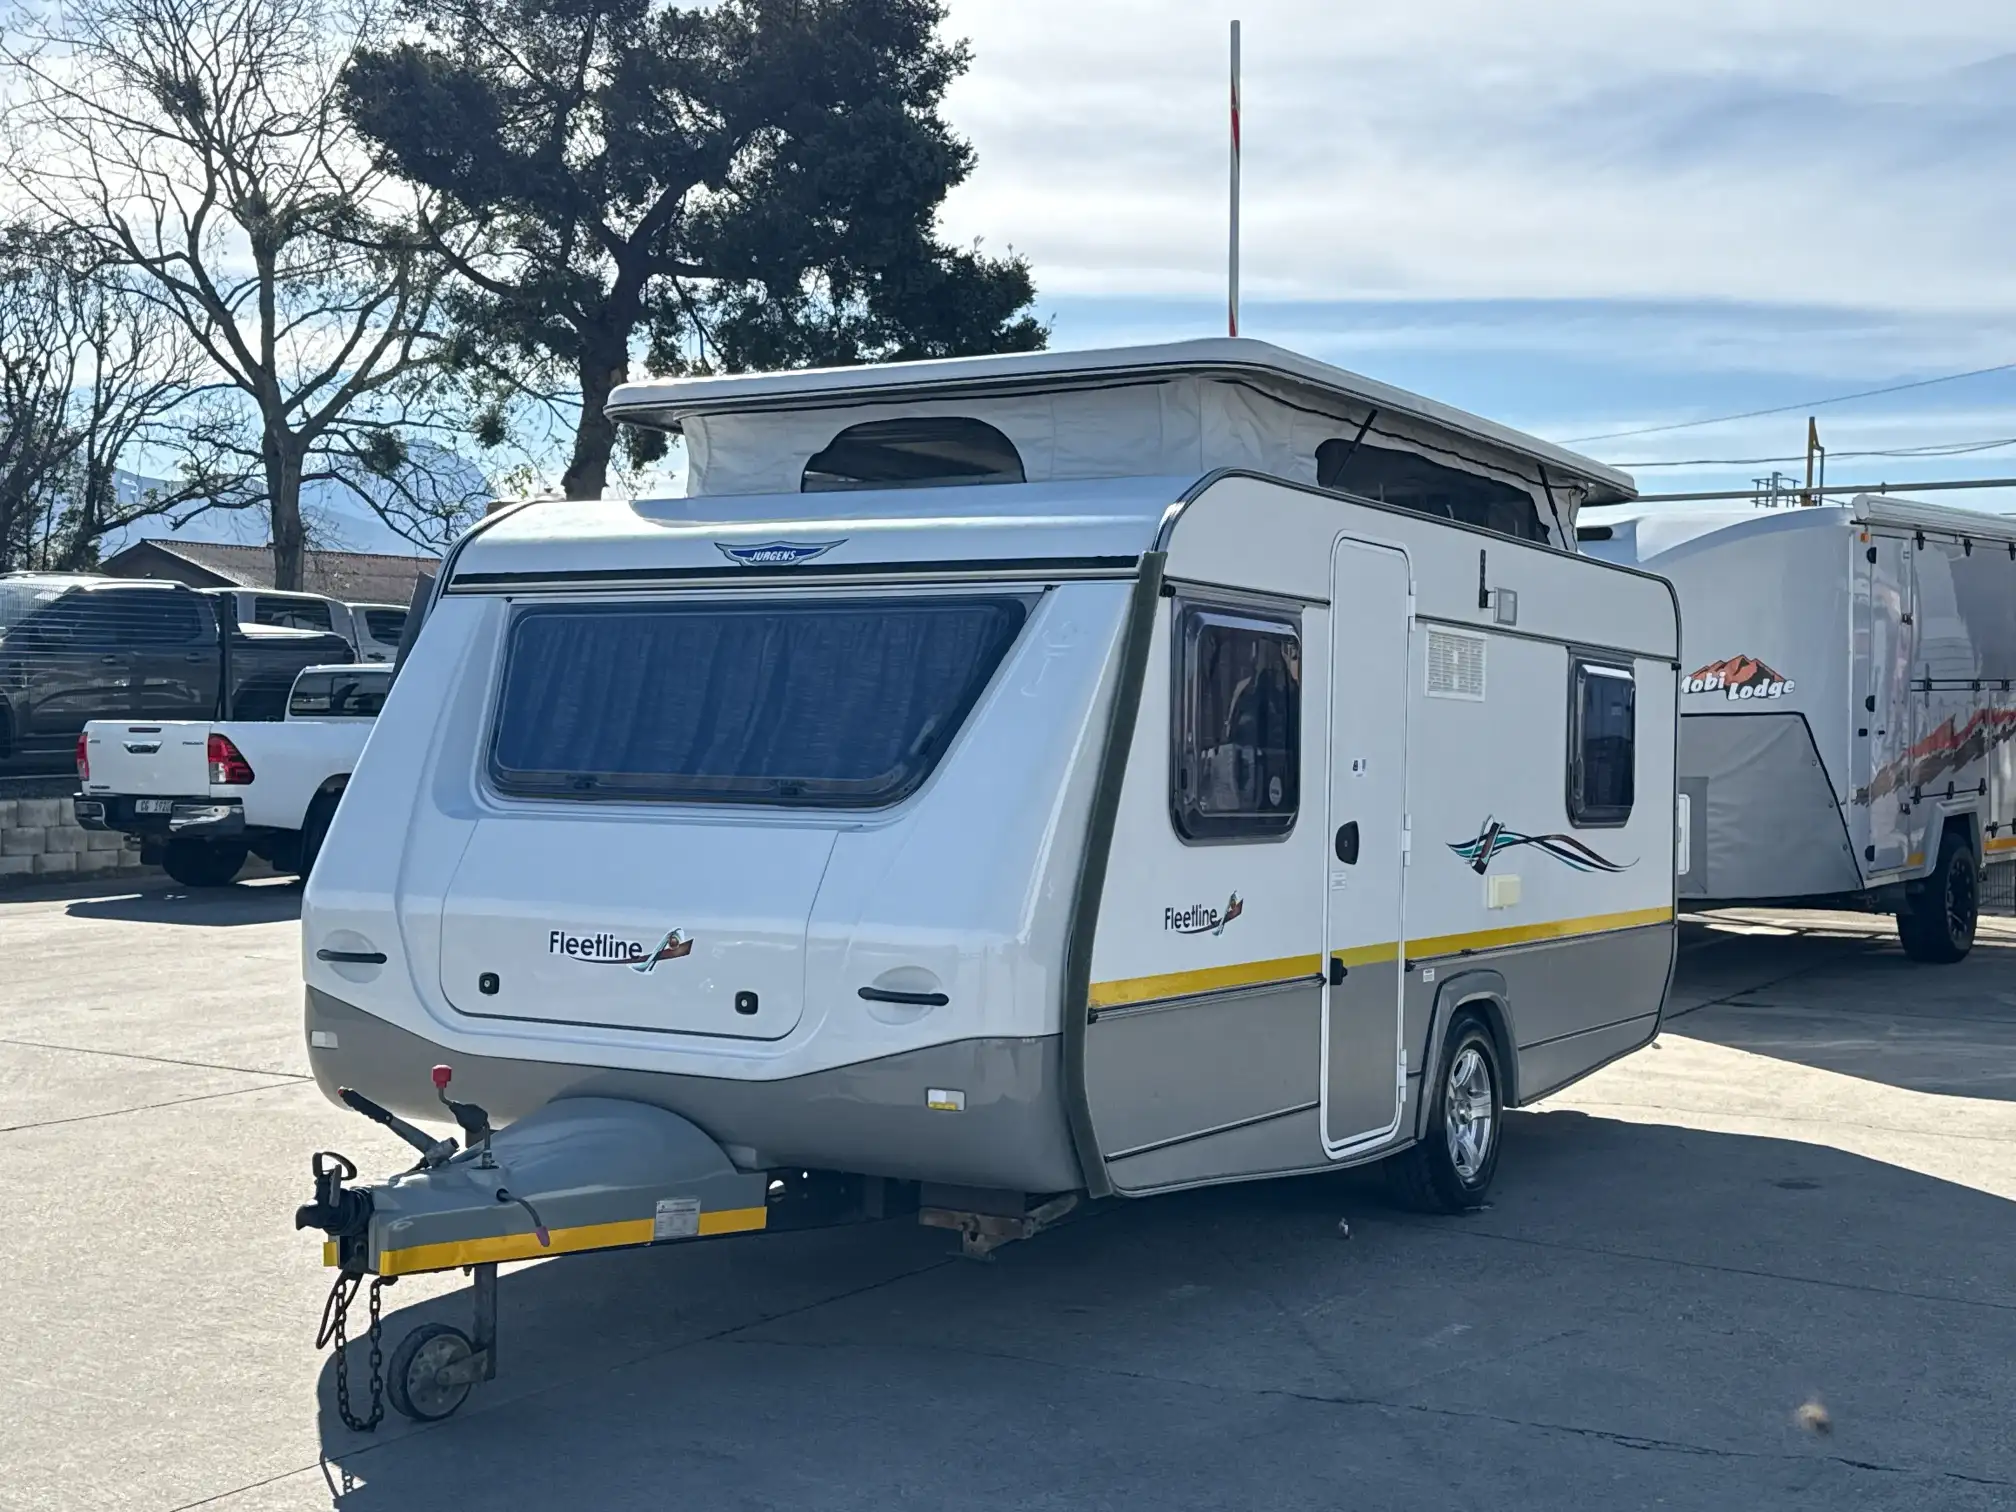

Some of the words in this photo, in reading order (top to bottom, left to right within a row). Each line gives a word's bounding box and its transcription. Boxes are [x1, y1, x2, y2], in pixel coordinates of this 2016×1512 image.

[750, 546, 797, 561] JURGENS
[1727, 679, 1795, 700] Lodge
[1164, 903, 1218, 930] Fleetline
[549, 931, 643, 959] Fleetline
